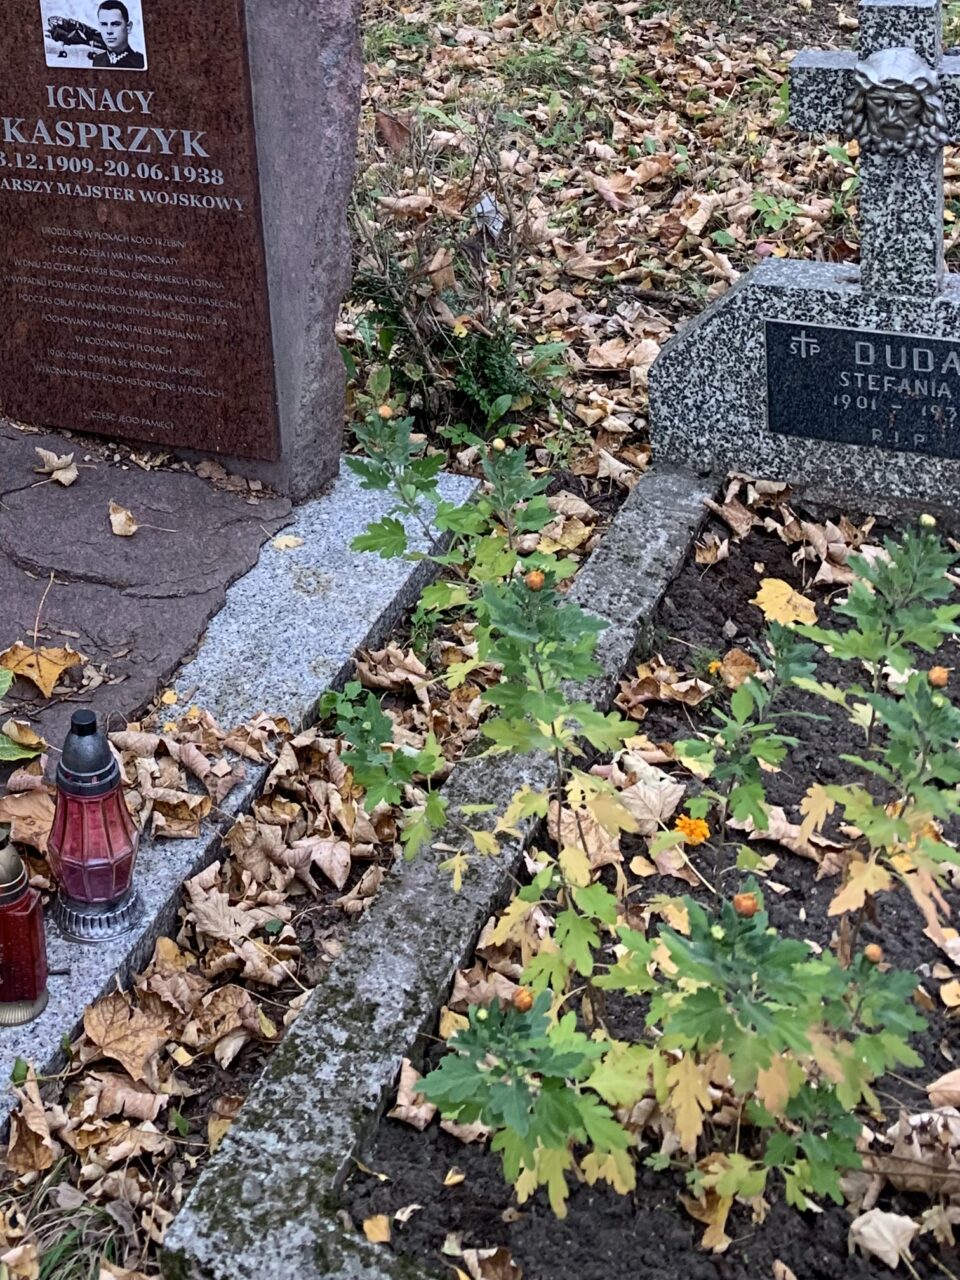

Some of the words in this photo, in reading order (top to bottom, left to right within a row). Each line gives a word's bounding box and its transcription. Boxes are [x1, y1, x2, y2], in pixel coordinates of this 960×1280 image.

[46, 85, 155, 114] IGNACY
[1, 117, 210, 158] KASPRZYK
[57, 182, 136, 202] MAJSTER
[138, 190, 247, 212] WOJSKOWY
[84, 230, 92, 239] W
[58, 245, 78, 256] OJCA
[111, 252, 134, 261] MATKI
[135, 254, 179, 266] HONORATY
[42, 261, 52, 270] 20
[54, 262, 90, 274] CZERWCA
[92, 267, 108, 276] 1938
[109, 270, 130, 279] ROKU
[132, 272, 152, 282] GINIE
[192, 278, 224, 289] LOTNIKA
[10, 276, 47, 286] WYPADKU
[48, 280, 64, 288] POD
[198, 297, 242, 309] PIASECZNA
[18, 294, 52, 304] PODCZAS
[54, 298, 106, 311] OBLATYWANIA
[108, 305, 150, 317] PROTOTYPU
[152, 310, 194, 322] SAMOLOTU
[42, 314, 92, 326] POCHOWANY
[93, 320, 105, 328] NA
[106, 322, 152, 335] CMENTARZU
[154, 328, 204, 341] PARAFIALNYM
[75, 336, 84, 344] W
[85, 337, 135, 350] RODZINNYCH
[34, 364, 79, 377] WYKONANA
[80, 371, 102, 381] PRZEZ
[125, 378, 176, 392] HISTORYCZNE
[178, 384, 187, 393] W
[130, 360, 177, 374] RENOWACJA
[178, 368, 206, 378] GROBU
[839, 372, 952, 398] STEFANIA
[833, 394, 877, 410] 1901
[118, 415, 140, 424] JEGO
